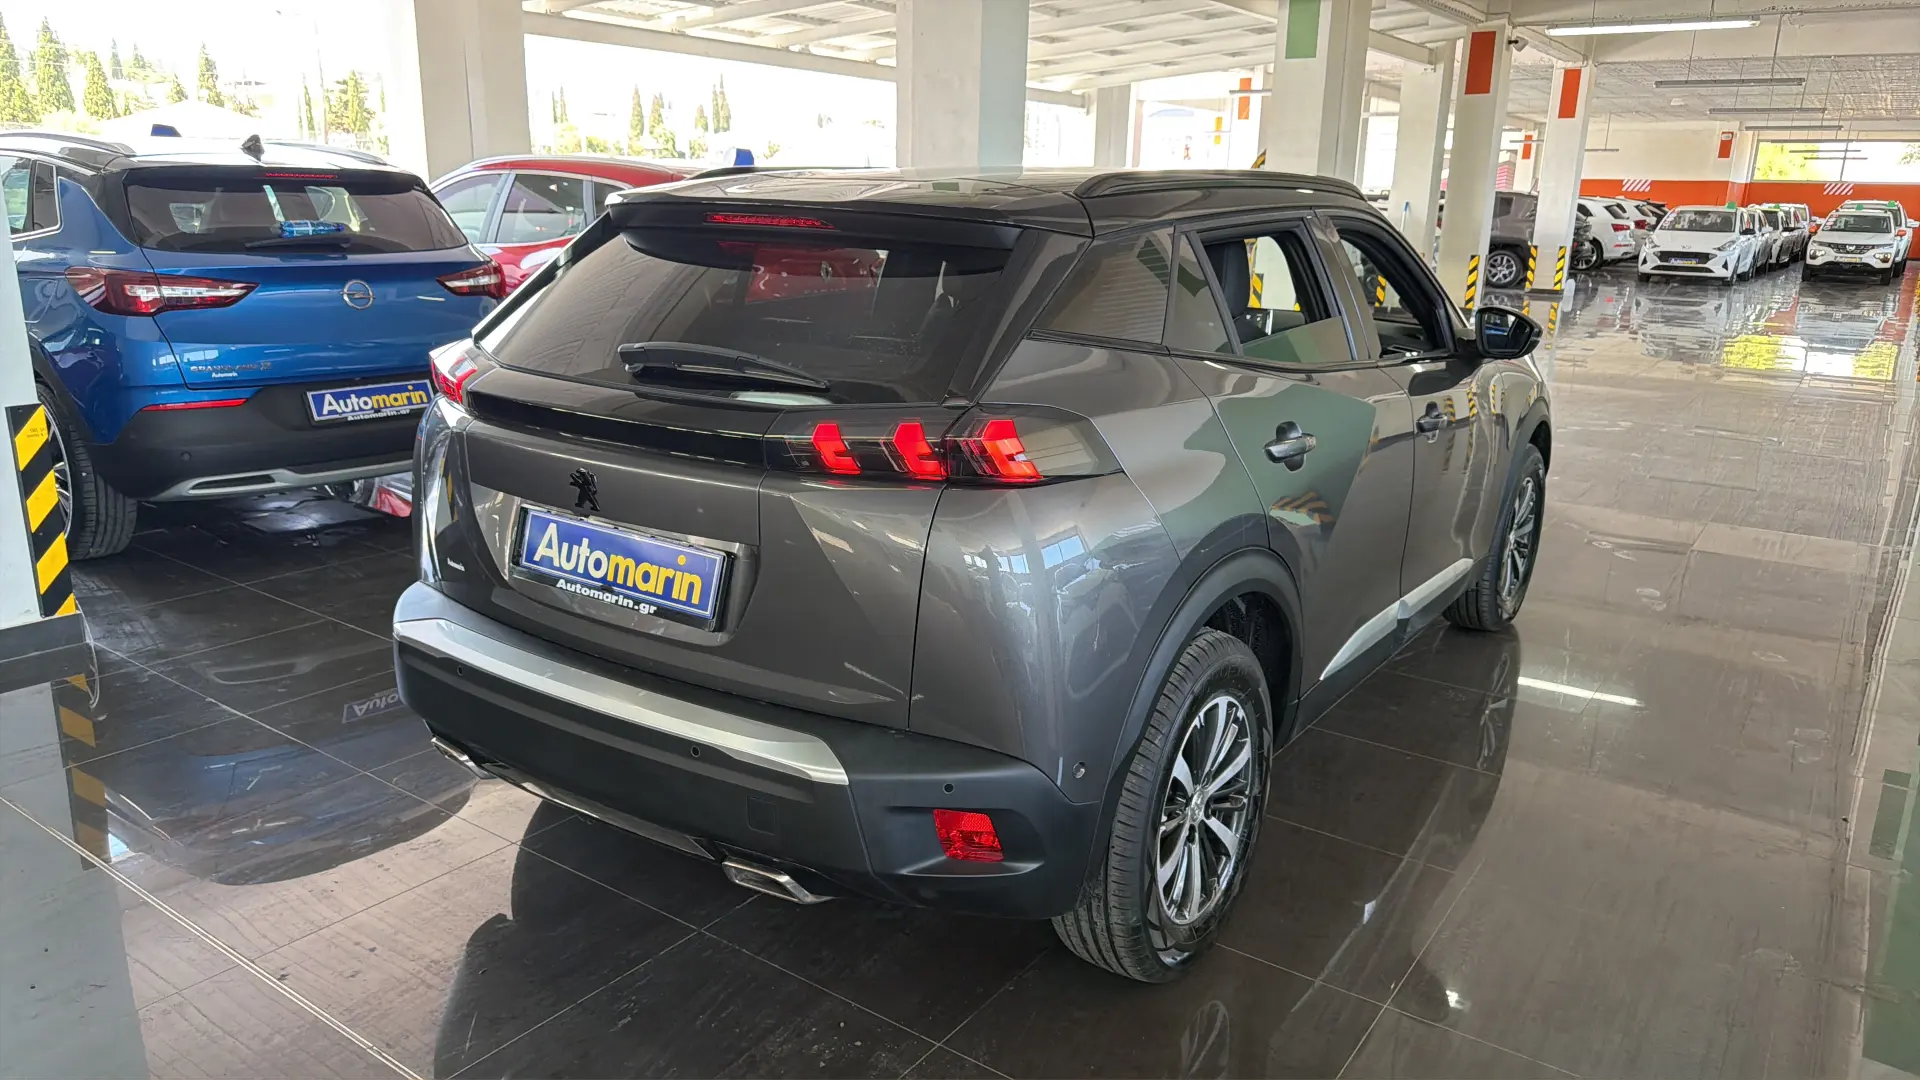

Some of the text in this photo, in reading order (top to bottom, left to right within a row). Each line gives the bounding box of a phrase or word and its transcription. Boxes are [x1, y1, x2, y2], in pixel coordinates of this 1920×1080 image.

[322, 385, 428, 415] Automarin
[533, 522, 702, 605] Automarin
[556, 579, 658, 615] Automarin.gr
